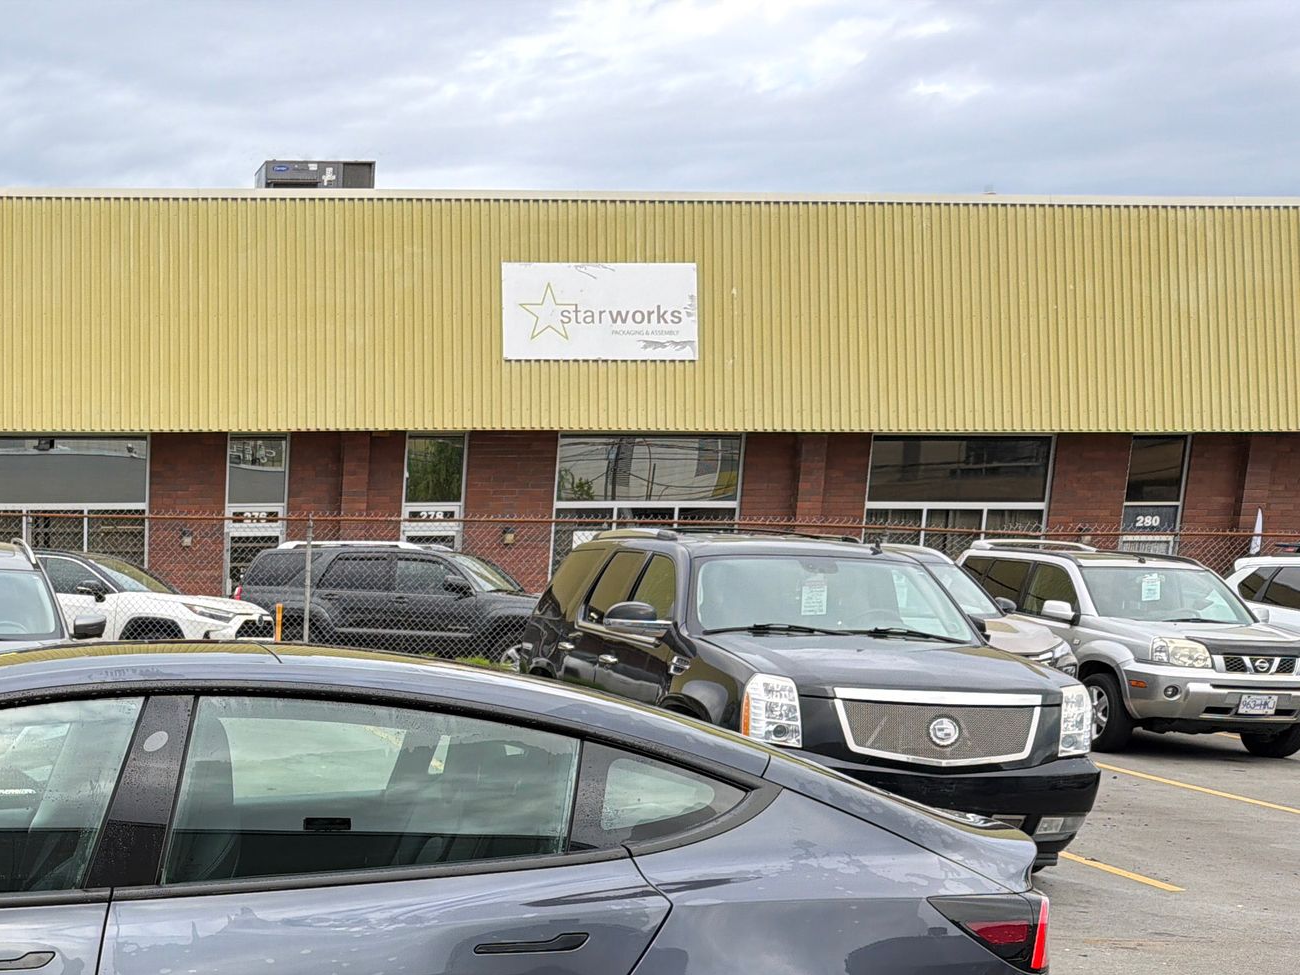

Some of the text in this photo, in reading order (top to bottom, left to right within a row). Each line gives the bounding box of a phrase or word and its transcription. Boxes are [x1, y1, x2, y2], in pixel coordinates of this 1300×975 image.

[560, 304, 682, 325] starworks
[419, 511, 445, 520] 278
[1135, 515, 1160, 527] 280
